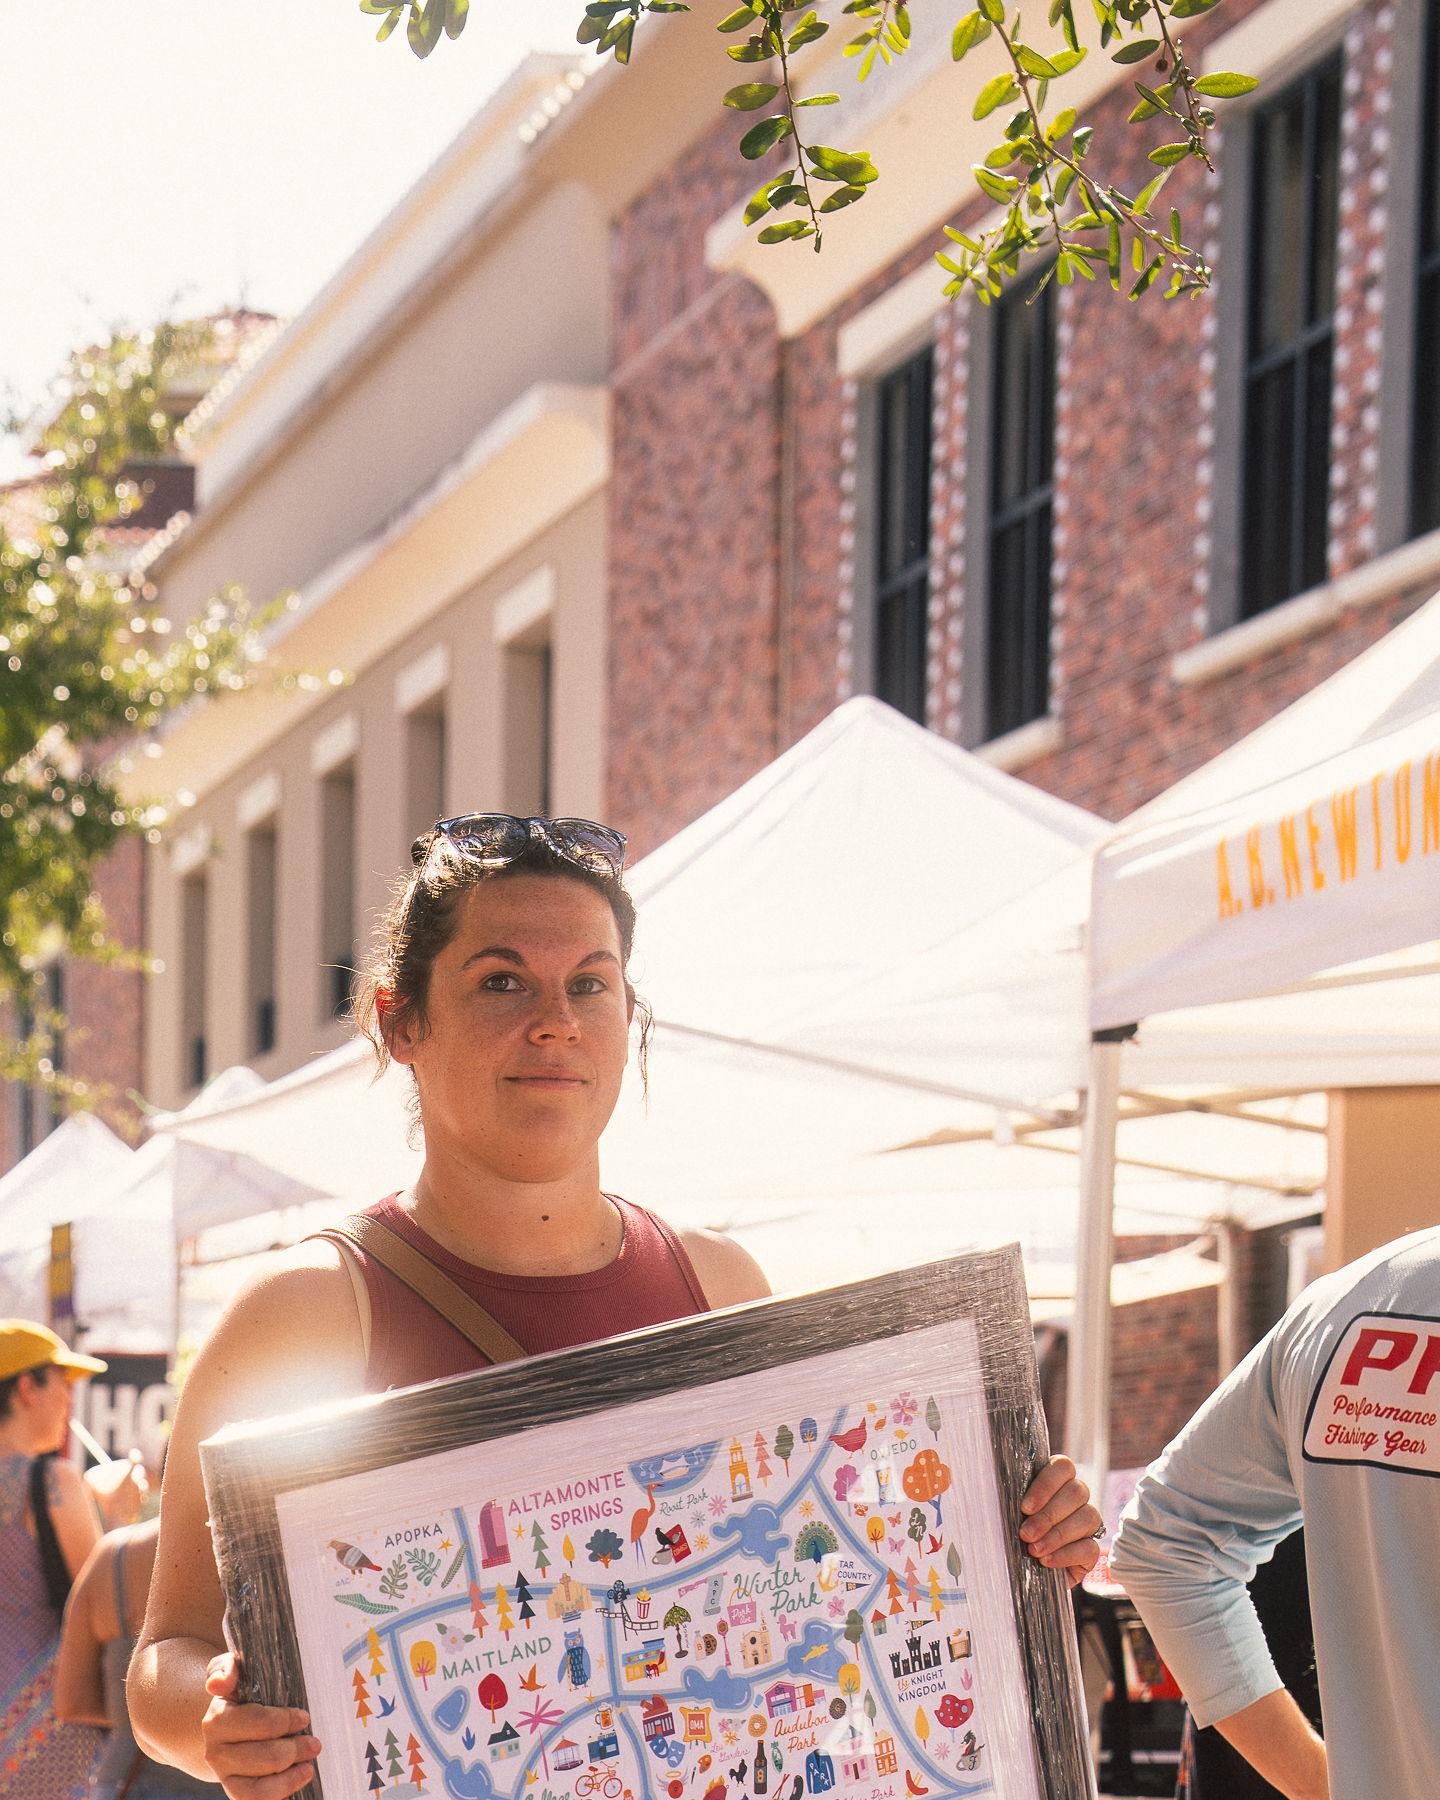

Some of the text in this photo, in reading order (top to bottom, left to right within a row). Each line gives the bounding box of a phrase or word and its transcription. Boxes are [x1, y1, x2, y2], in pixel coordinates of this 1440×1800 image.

[1333, 1394, 1437, 1427] Performance
[1325, 1423, 1428, 1457] Fishing Gear
[508, 1471, 627, 1517] ALTAMONTE
[685, 1488, 709, 1512] Park
[550, 1497, 624, 1532] SPRINGS
[384, 1522, 444, 1549] APOPKA
[837, 1570, 873, 1582] COUNTRY
[839, 1561, 855, 1570] TAR
[733, 1560, 806, 1600] Winter
[770, 1583, 824, 1618] Park
[442, 1636, 553, 1682] MAITLAND
[910, 1669, 944, 1686] KNIGHT
[897, 1681, 947, 1704] KINGDOM
[774, 1710, 831, 1738] Audubon
[787, 1732, 819, 1754] Park
